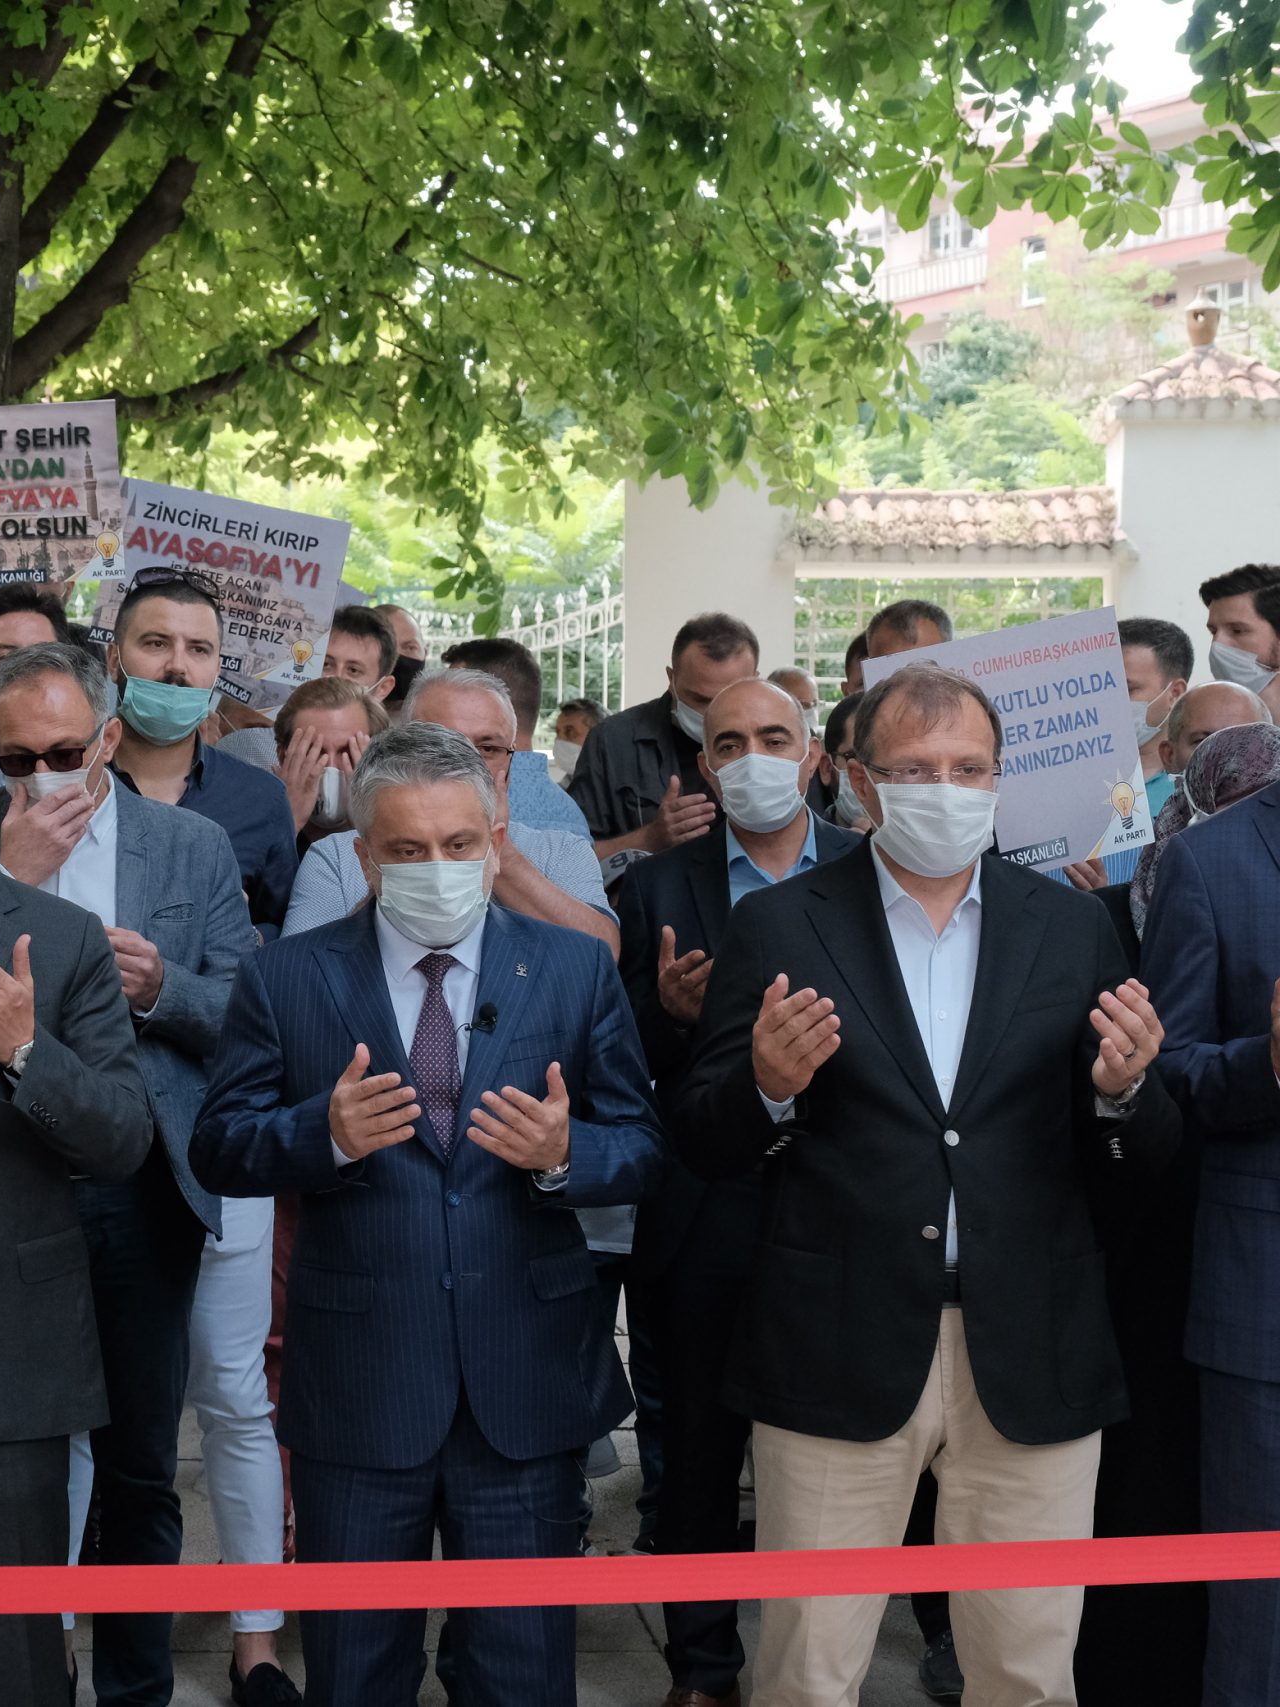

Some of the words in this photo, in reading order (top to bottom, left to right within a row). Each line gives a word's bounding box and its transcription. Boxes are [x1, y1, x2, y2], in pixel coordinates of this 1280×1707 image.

[16, 422, 91, 452] ŞEHİR
[1, 516, 87, 538] OLSUN
[143, 500, 259, 541] ZİNCİRLERİ
[264, 527, 319, 552] KIRIP
[126, 526, 320, 589] AYASOFYA'YI
[220, 589, 279, 611] ŞKANIMIZ
[89, 628, 103, 640] AK
[228, 607, 303, 632] ERDOĞAN'A
[228, 622, 284, 645] EDERİZ
[972, 631, 1118, 677] CUMHURBAŞKANIMIZ
[989, 684, 1049, 715] KUTLU
[1052, 670, 1117, 701] YOLDA
[1001, 723, 1031, 748] ER
[1034, 707, 1100, 740] ZAMAN
[1003, 734, 1114, 778] ANINIZDAYIZ
[1113, 834, 1124, 845] AK
